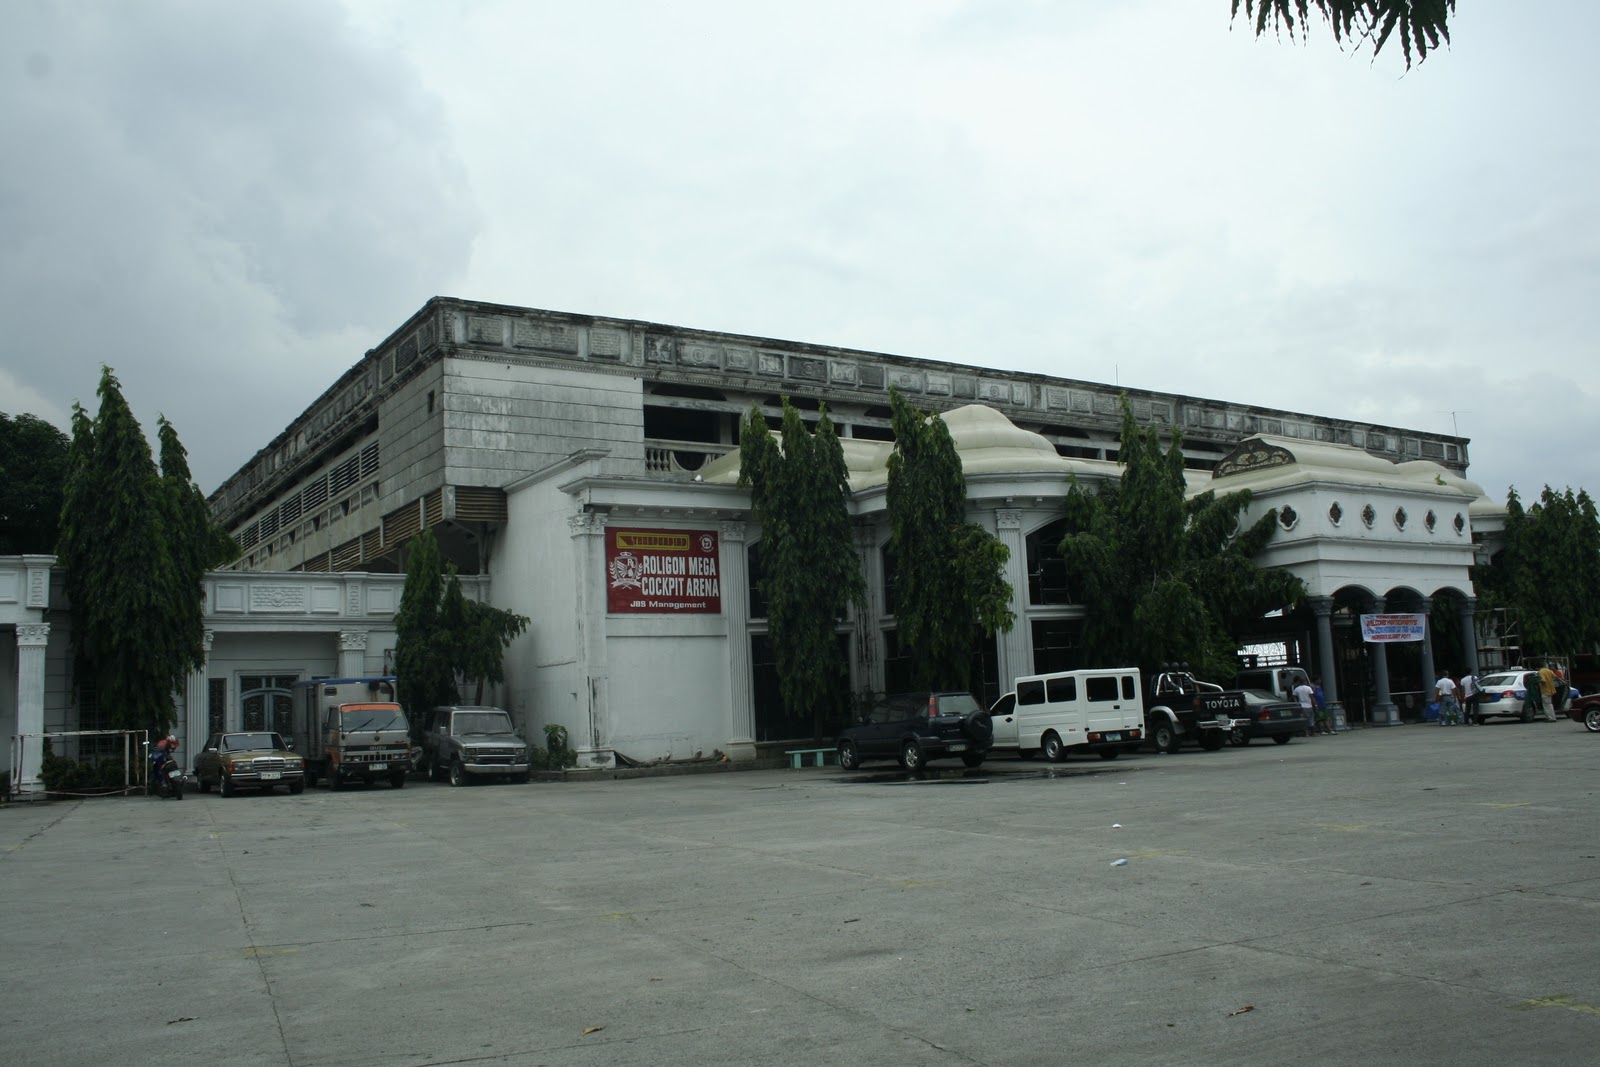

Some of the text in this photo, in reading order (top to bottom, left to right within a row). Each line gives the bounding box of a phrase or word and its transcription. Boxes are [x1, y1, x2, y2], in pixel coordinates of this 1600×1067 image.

[643, 555, 716, 576] ROLIGON MEGA
[642, 577, 684, 596] COCKPIT
[686, 578, 719, 597] ARENA
[630, 600, 706, 609] JBS Management
[1205, 699, 1240, 709] TOYOTA
